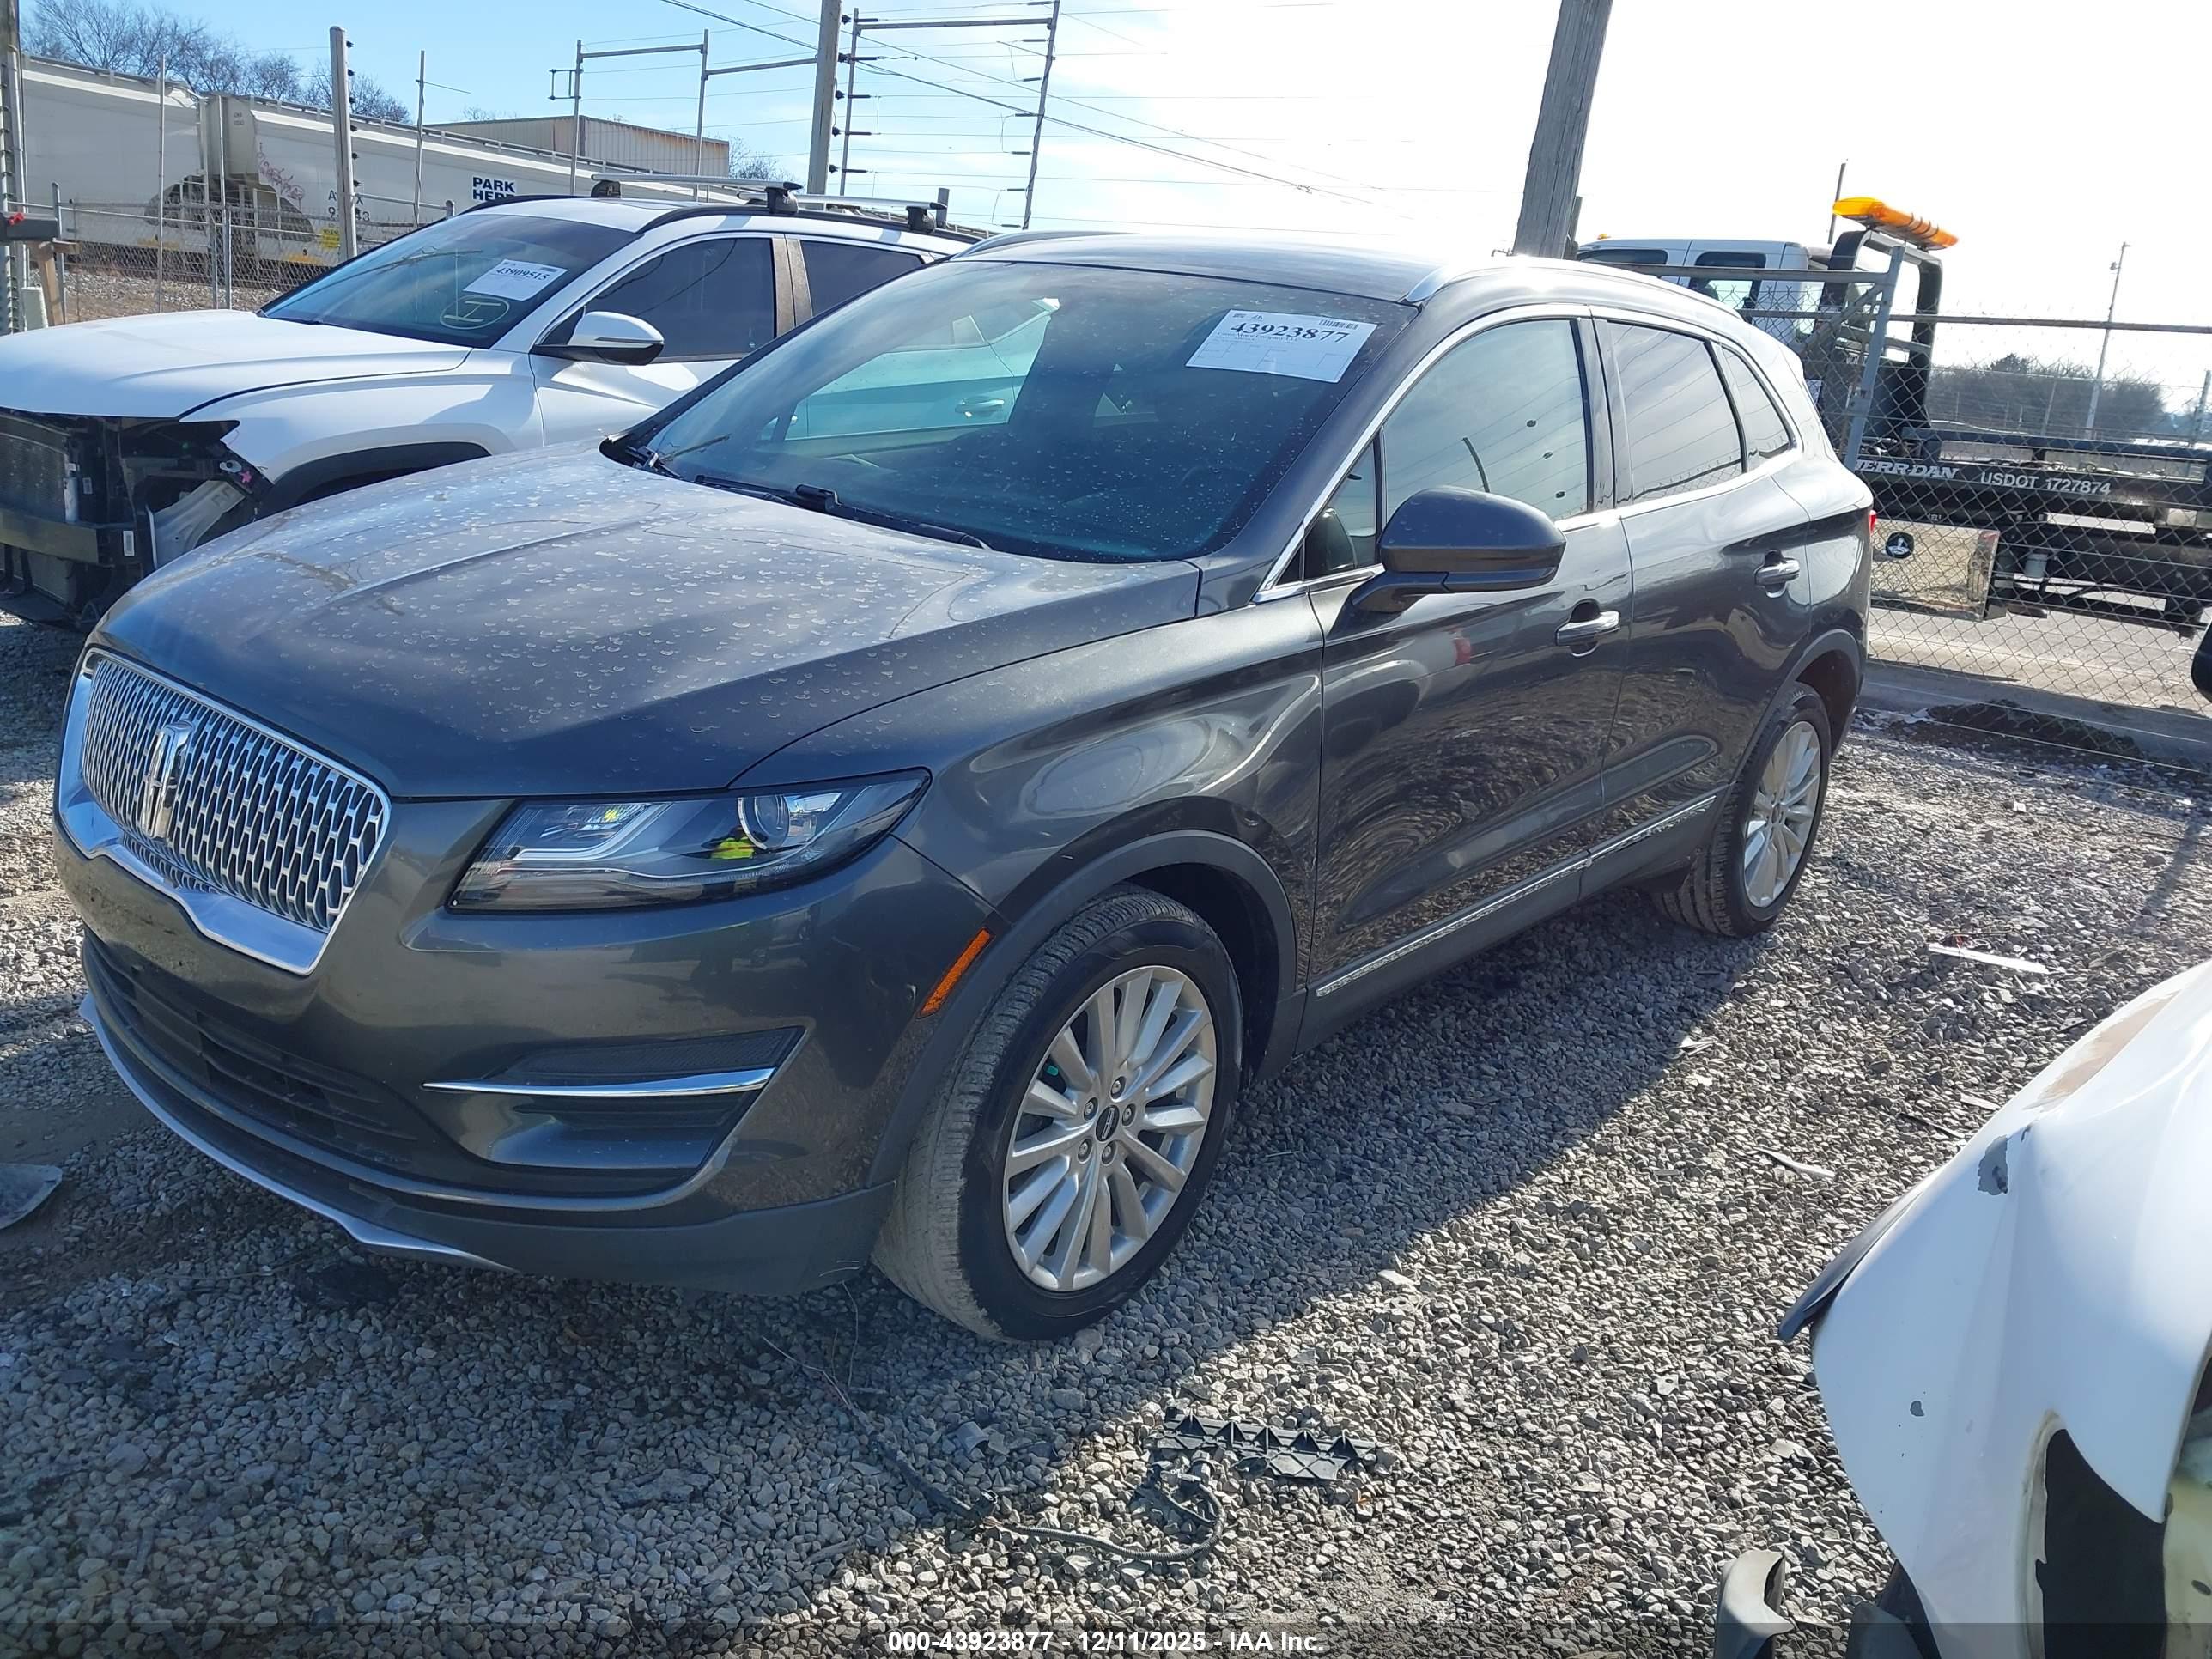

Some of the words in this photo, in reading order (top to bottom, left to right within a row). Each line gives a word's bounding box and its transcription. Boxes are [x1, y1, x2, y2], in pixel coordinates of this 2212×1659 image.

[473, 177, 515, 193] PARK
[496, 267, 550, 281] 43909515
[1231, 322, 1351, 343] 43923877
[1980, 471, 2039, 489] USDOT
[2045, 477, 2112, 495] 1727874
